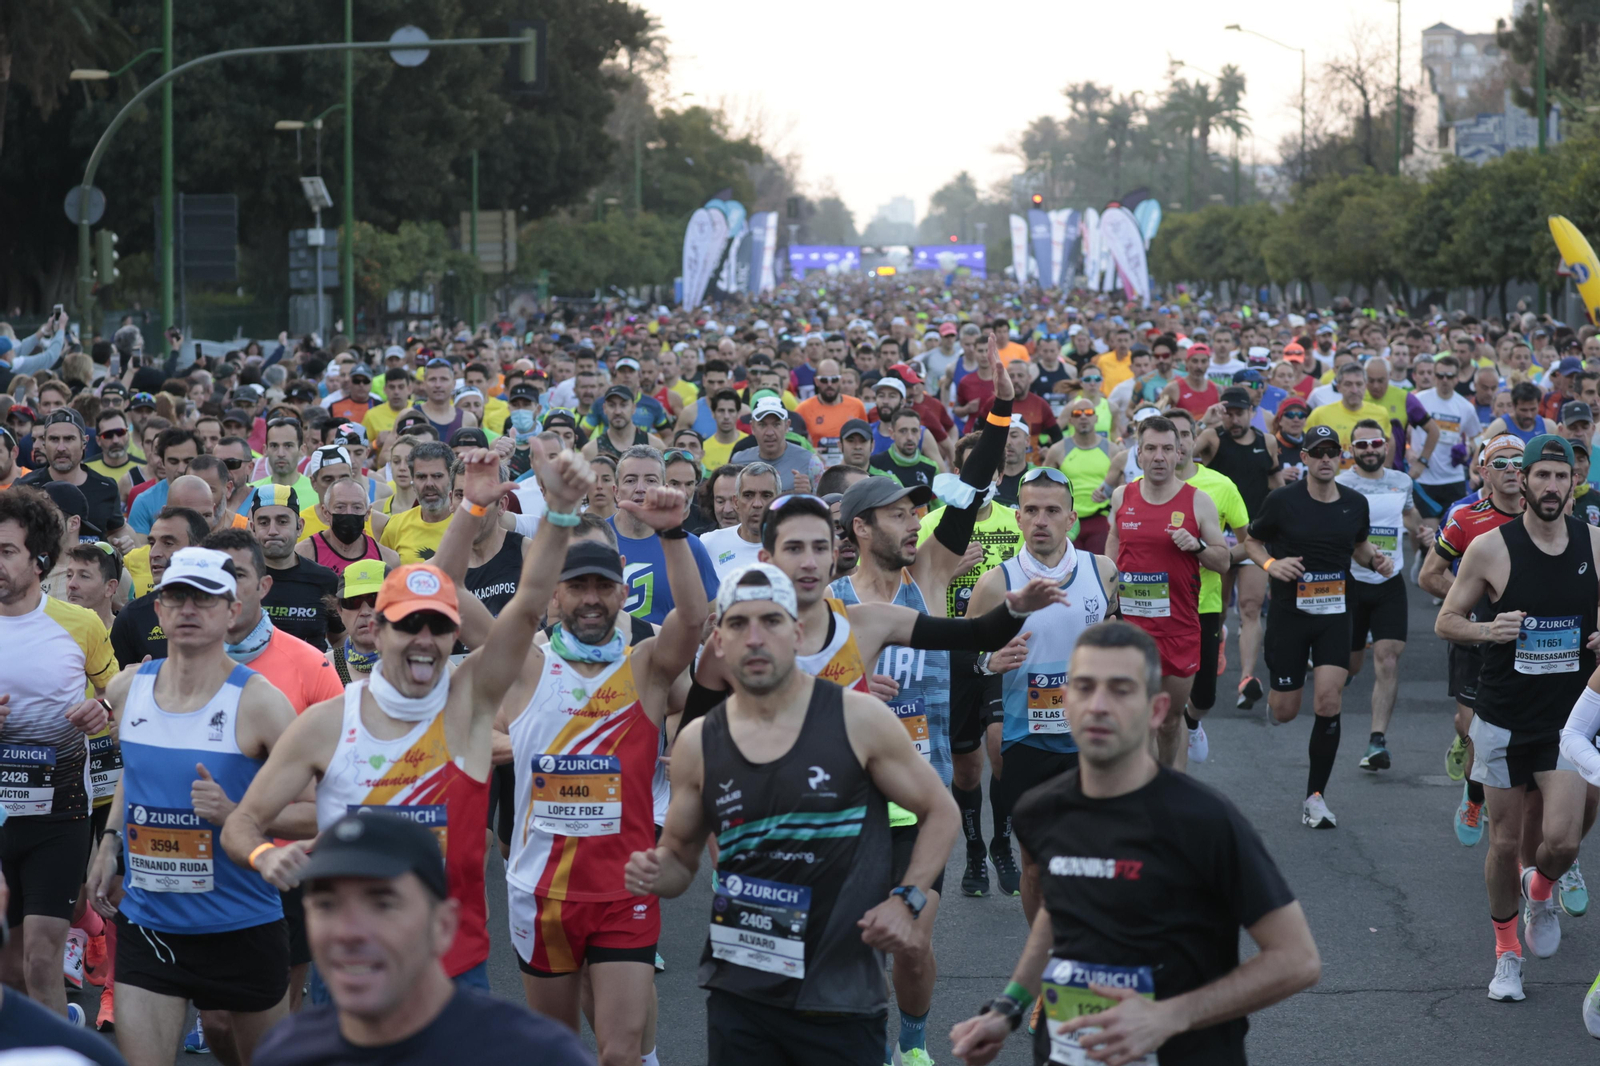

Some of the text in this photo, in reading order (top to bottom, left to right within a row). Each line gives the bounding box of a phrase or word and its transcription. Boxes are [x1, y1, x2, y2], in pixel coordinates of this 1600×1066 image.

[1371, 527, 1395, 535] ZURICH
[1133, 574, 1162, 582] ZURICH
[1313, 572, 1341, 581] ZURICH
[475, 582, 516, 600] KACHOPOS
[1134, 589, 1151, 597] 1561
[1085, 614, 1099, 624] OTSO
[1539, 619, 1575, 629] ZURICH
[1535, 638, 1562, 648] 11651
[1515, 650, 1580, 661] JOSEMESASANTOS
[824, 662, 846, 681] life
[596, 686, 618, 705] life
[567, 707, 611, 722] running
[1032, 710, 1061, 719] DE LAS
[2, 748, 47, 761] ZURICH
[403, 748, 426, 768] life
[90, 759, 103, 771] 42
[557, 759, 609, 771] ZURICH
[1, 771, 29, 784] 2426
[365, 773, 419, 791] running
[0, 788, 30, 799] VÍCTOR
[559, 785, 590, 798] 4440
[548, 804, 604, 816] LOPEZ FDEZ
[149, 811, 200, 826] ZURICH
[150, 838, 180, 853] 3594
[131, 856, 209, 873] FERNANDO RUDA
[743, 882, 800, 904] ZURICH
[740, 911, 773, 931] 2405
[739, 933, 776, 951] ALVARO
[1073, 967, 1138, 989] ZURICH
